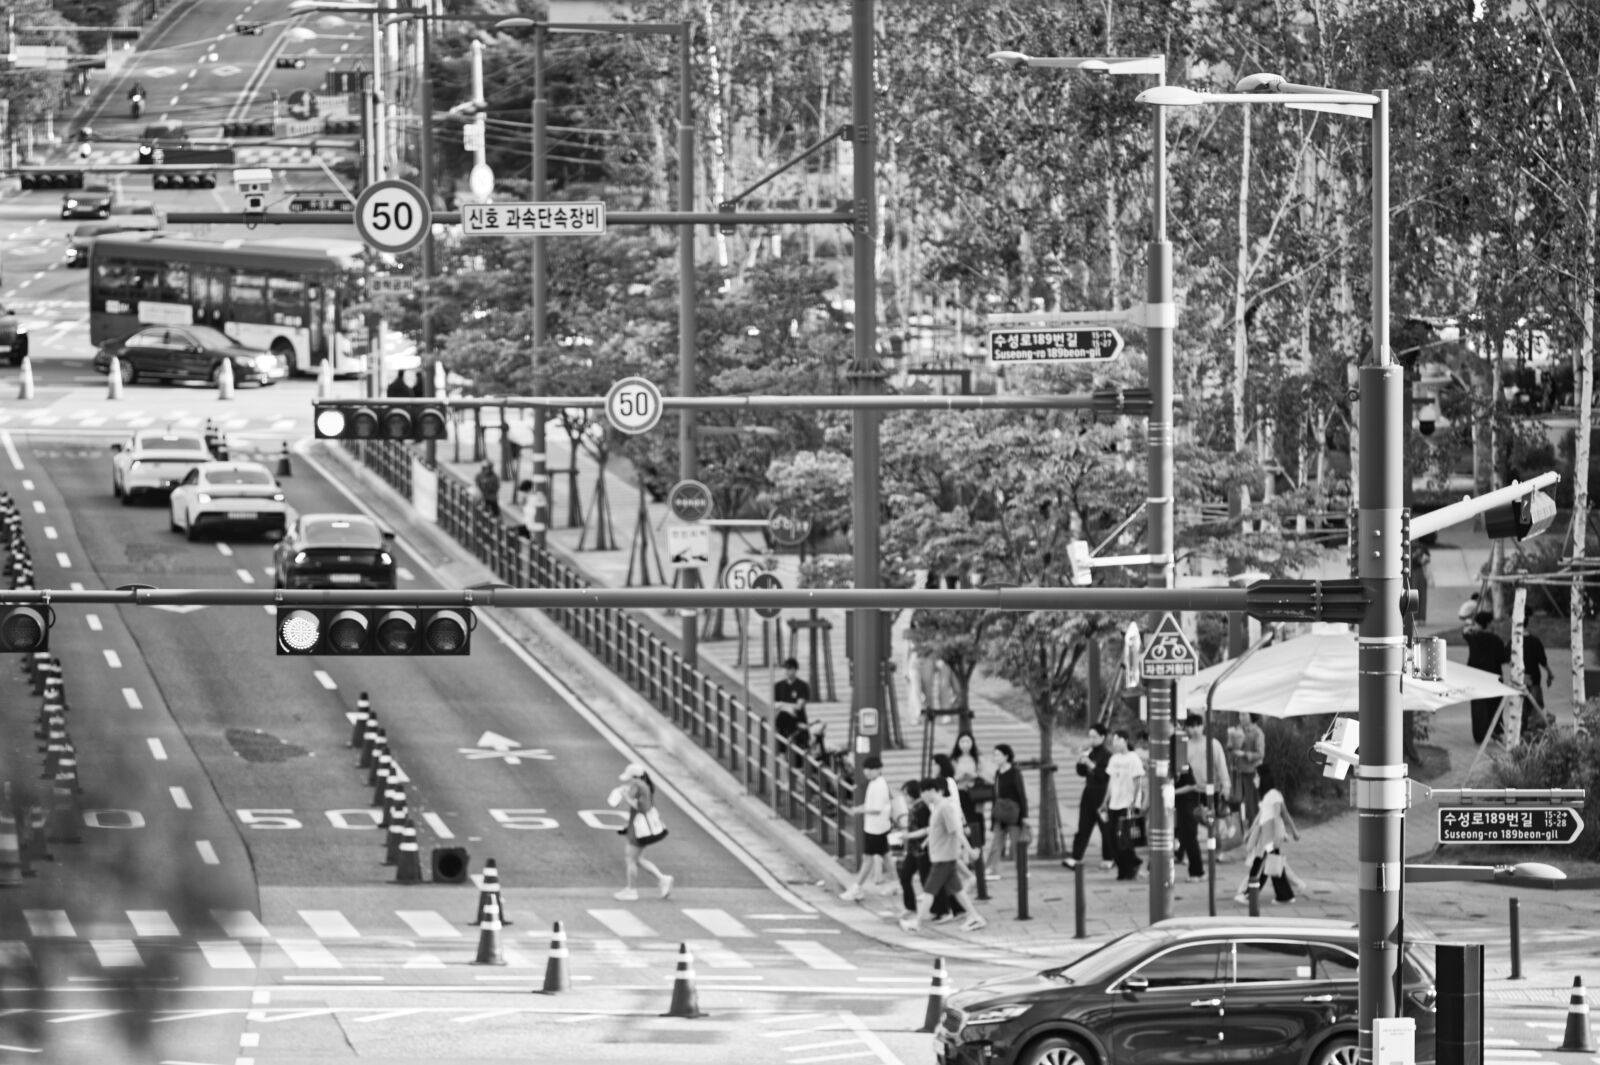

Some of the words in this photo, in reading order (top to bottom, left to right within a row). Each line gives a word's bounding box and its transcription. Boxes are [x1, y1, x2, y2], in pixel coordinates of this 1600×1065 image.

[372, 201, 413, 231] 50
[469, 208, 499, 230] 신호
[506, 207, 599, 229] 과속단속장비
[994, 332, 1078, 349] 수성로189번길
[994, 349, 1046, 360] Suseong-ro
[1046, 347, 1101, 359] 189beon-gil
[620, 392, 648, 416] 50
[1444, 812, 1533, 828] 수성로189번길
[1544, 811, 1562, 819] 15-2
[1544, 819, 1567, 827] 15-28
[1444, 829, 1498, 841] Suseong-ro
[1501, 829, 1558, 841] 189beon-gil
